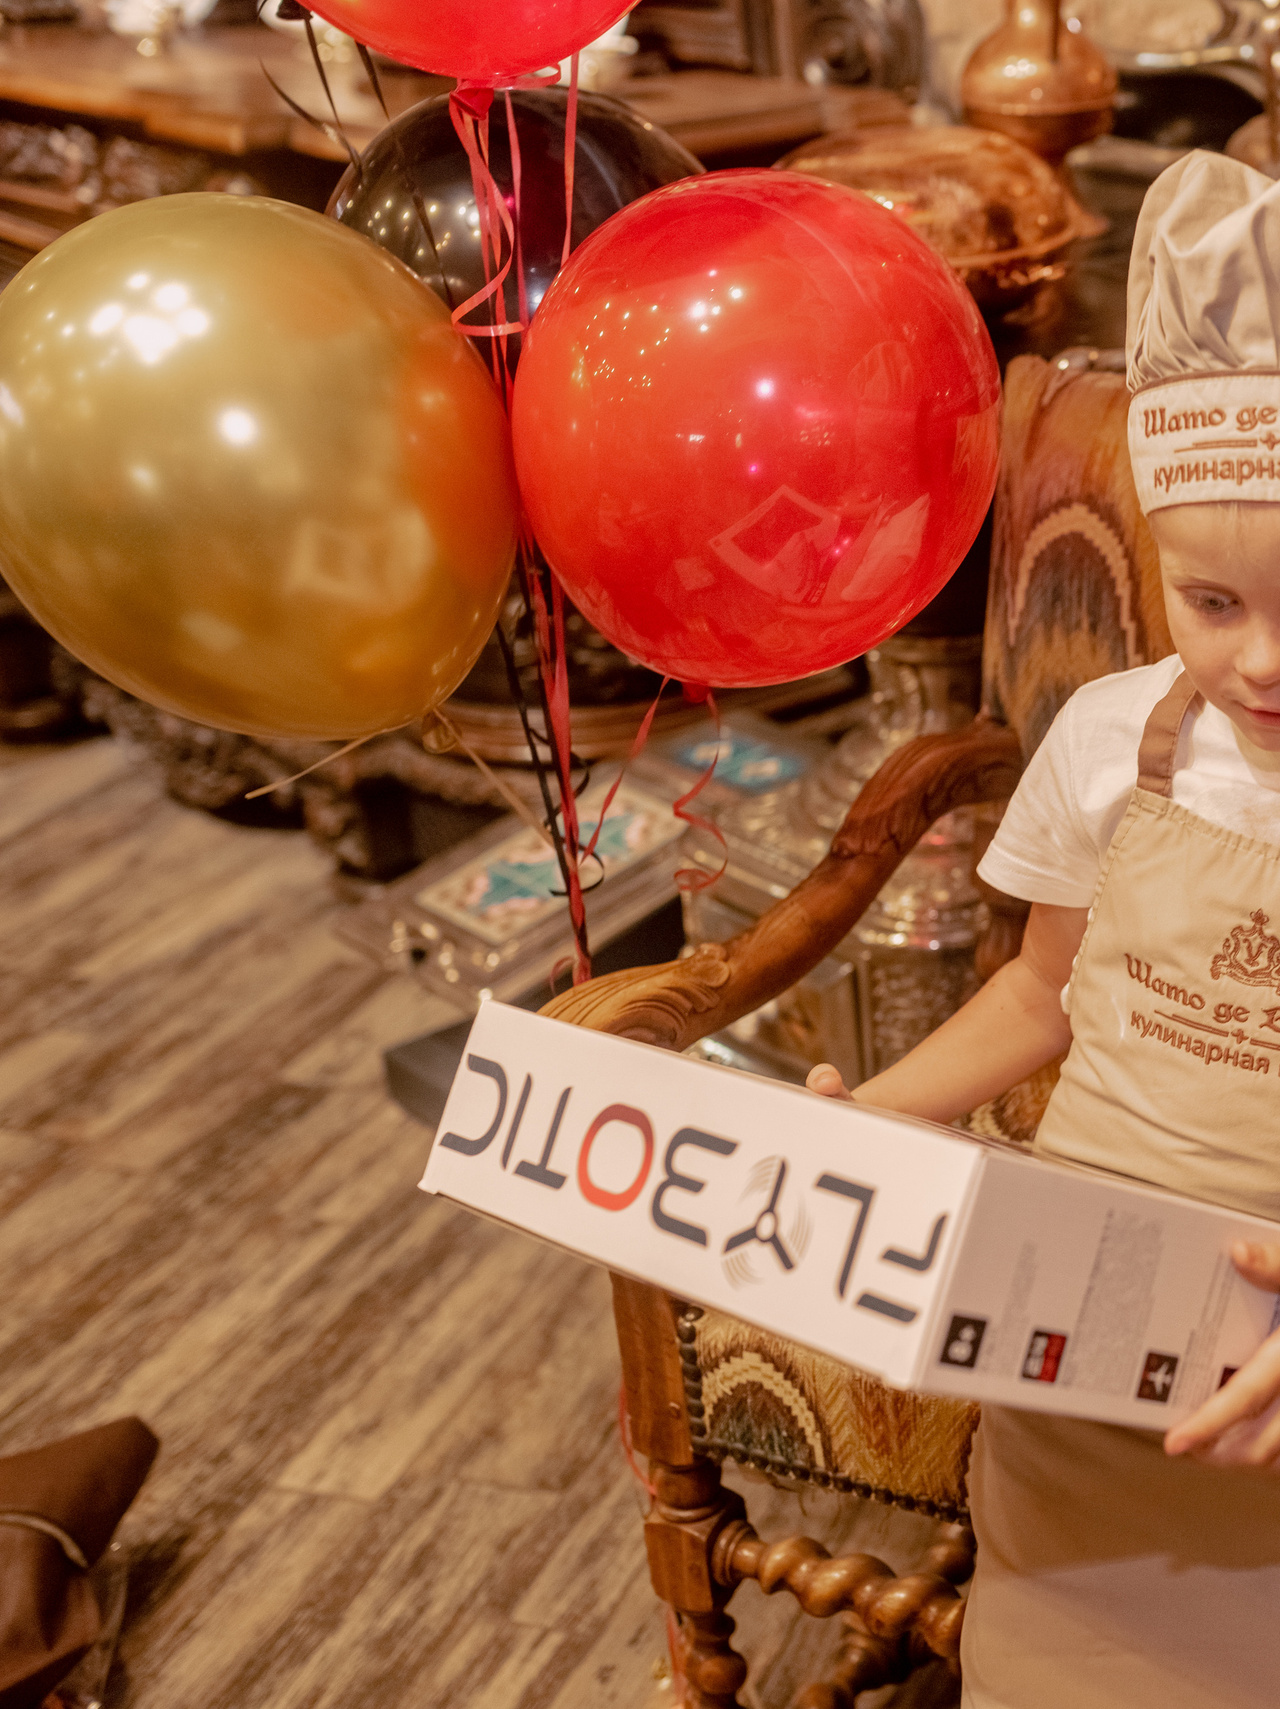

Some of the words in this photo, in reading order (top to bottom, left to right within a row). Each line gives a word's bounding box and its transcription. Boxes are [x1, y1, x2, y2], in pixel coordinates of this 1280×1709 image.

[1144, 405, 1227, 438] Шато
[1236, 405, 1279, 433] де
[1124, 952, 1206, 1010] Шато
[1213, 1001, 1251, 1024] де
[1130, 1010, 1271, 1075] кулинарная
